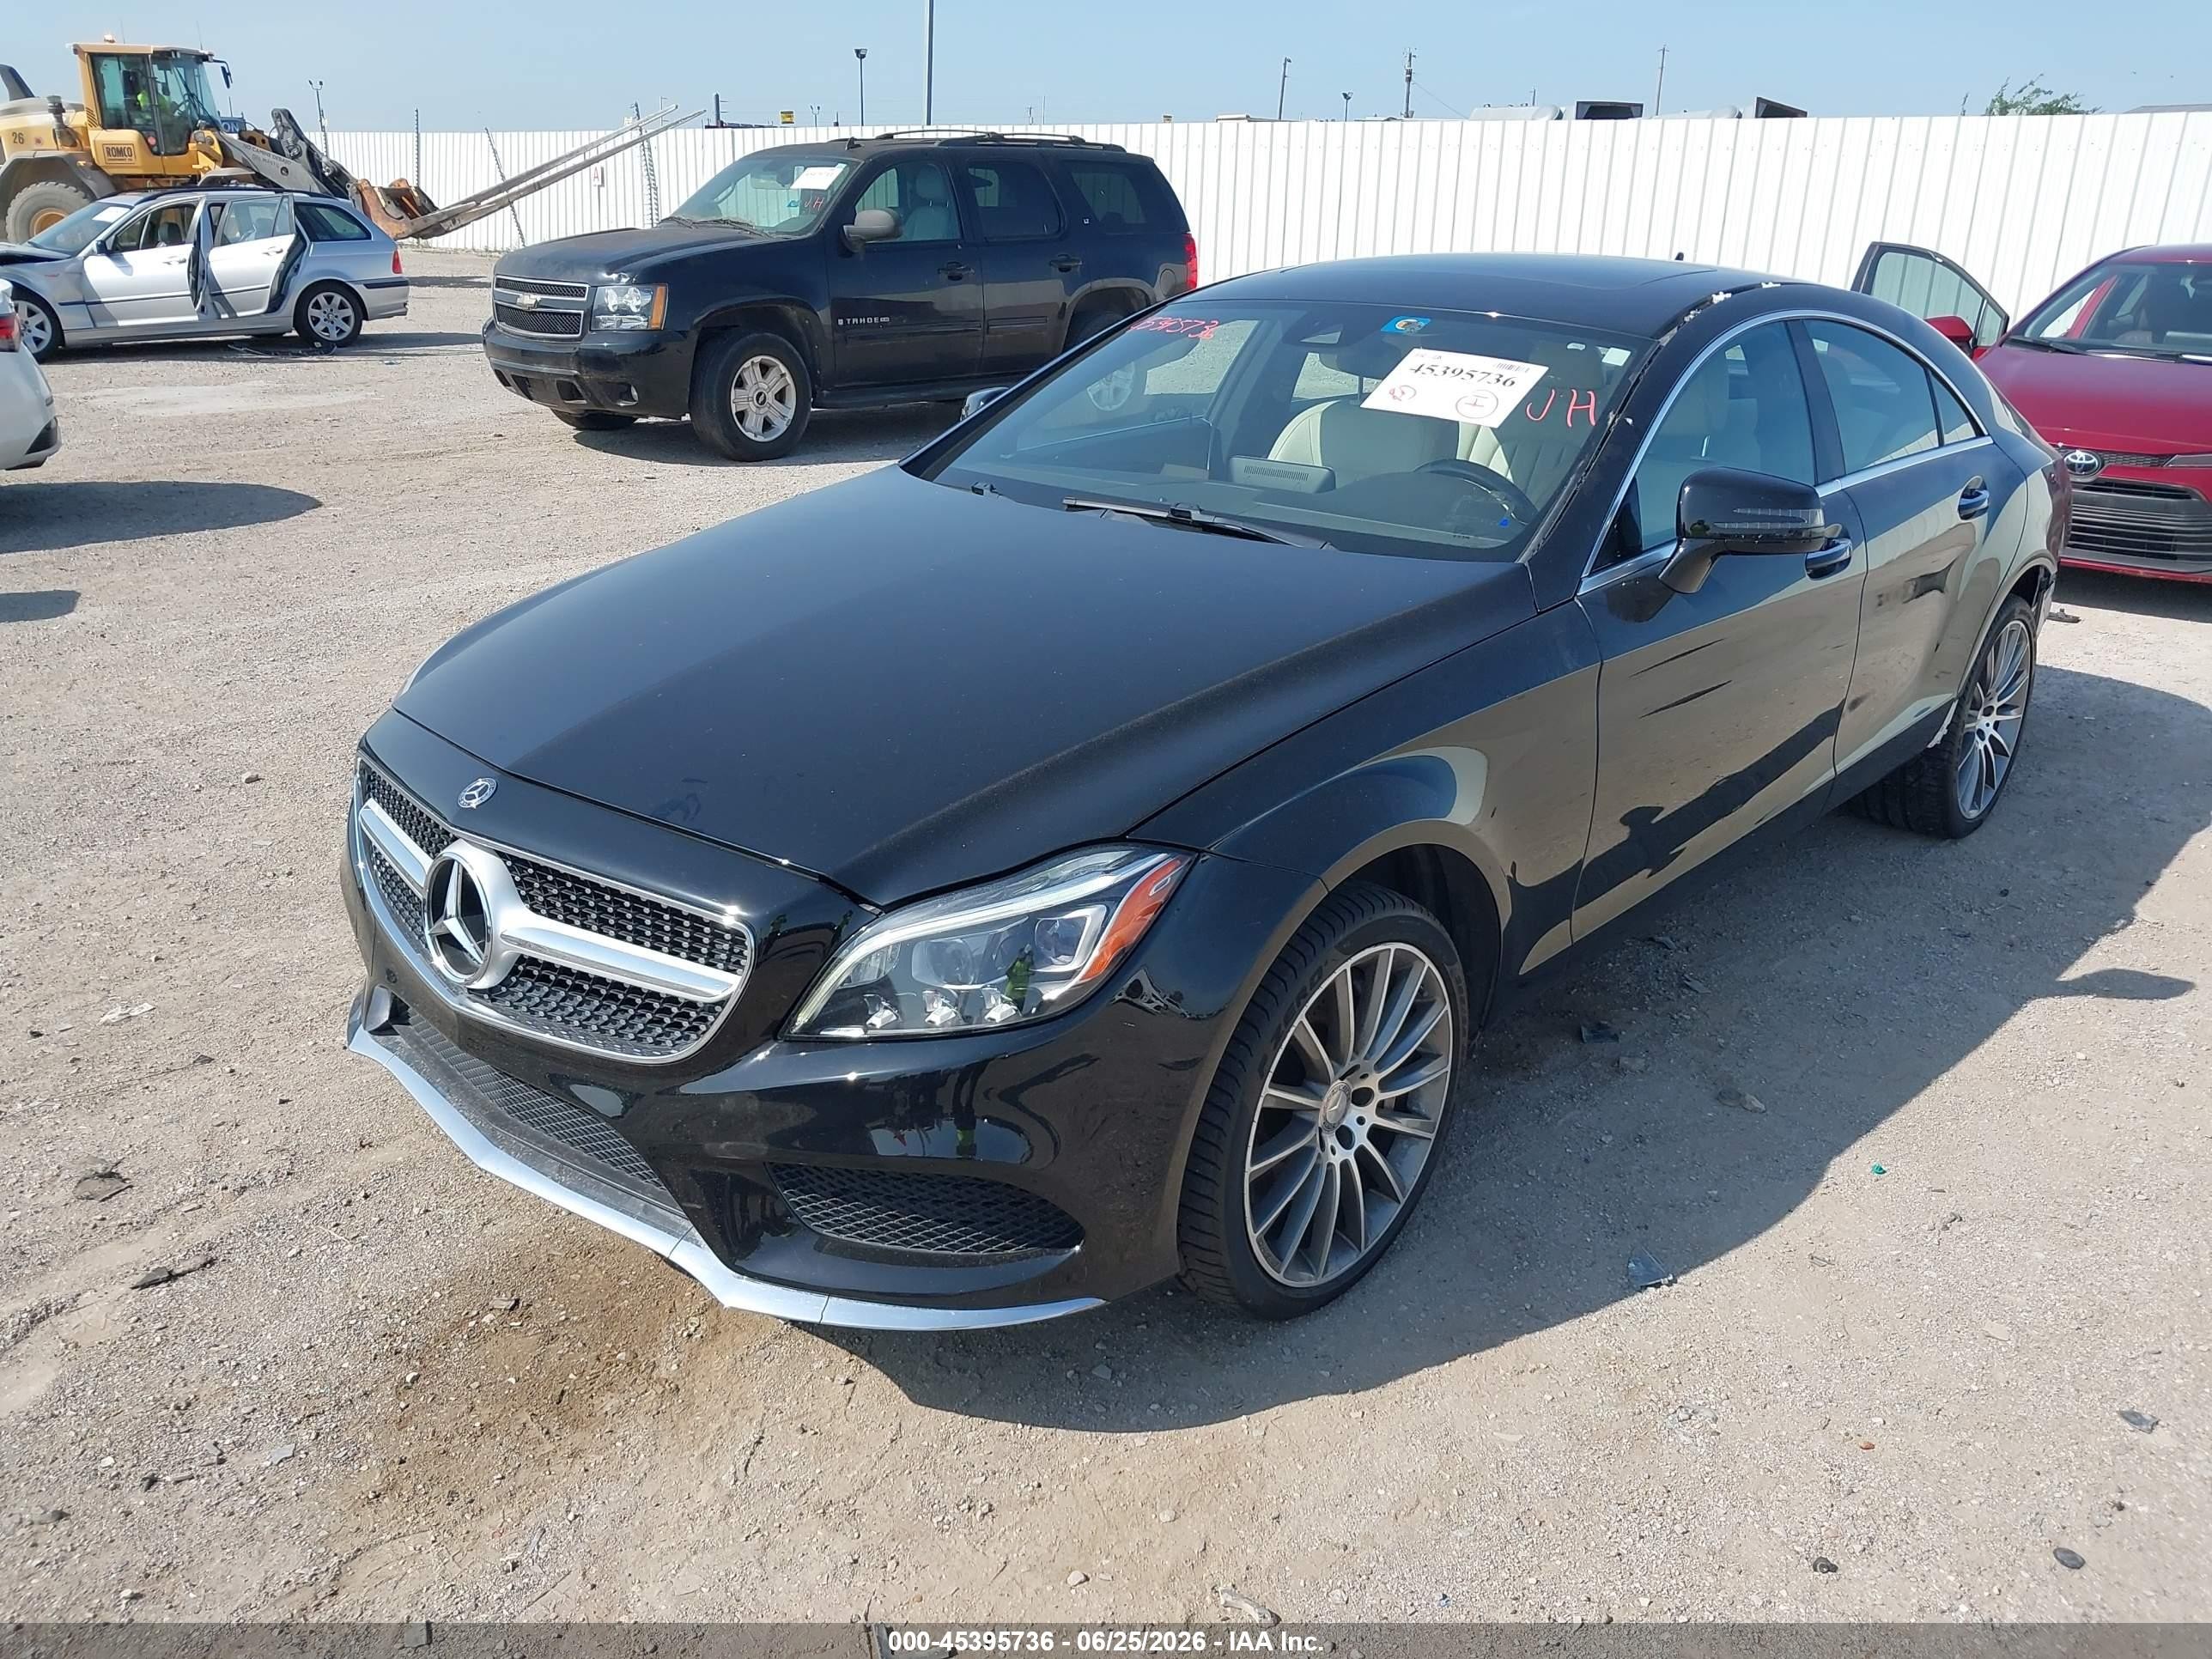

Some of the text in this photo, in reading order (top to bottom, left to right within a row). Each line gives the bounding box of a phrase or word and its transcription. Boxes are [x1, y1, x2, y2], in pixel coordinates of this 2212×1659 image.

[11, 131, 25, 145] 26
[106, 146, 133, 158] ROMCO
[592, 166, 600, 182] A
[1409, 362, 1516, 388] 45395736
